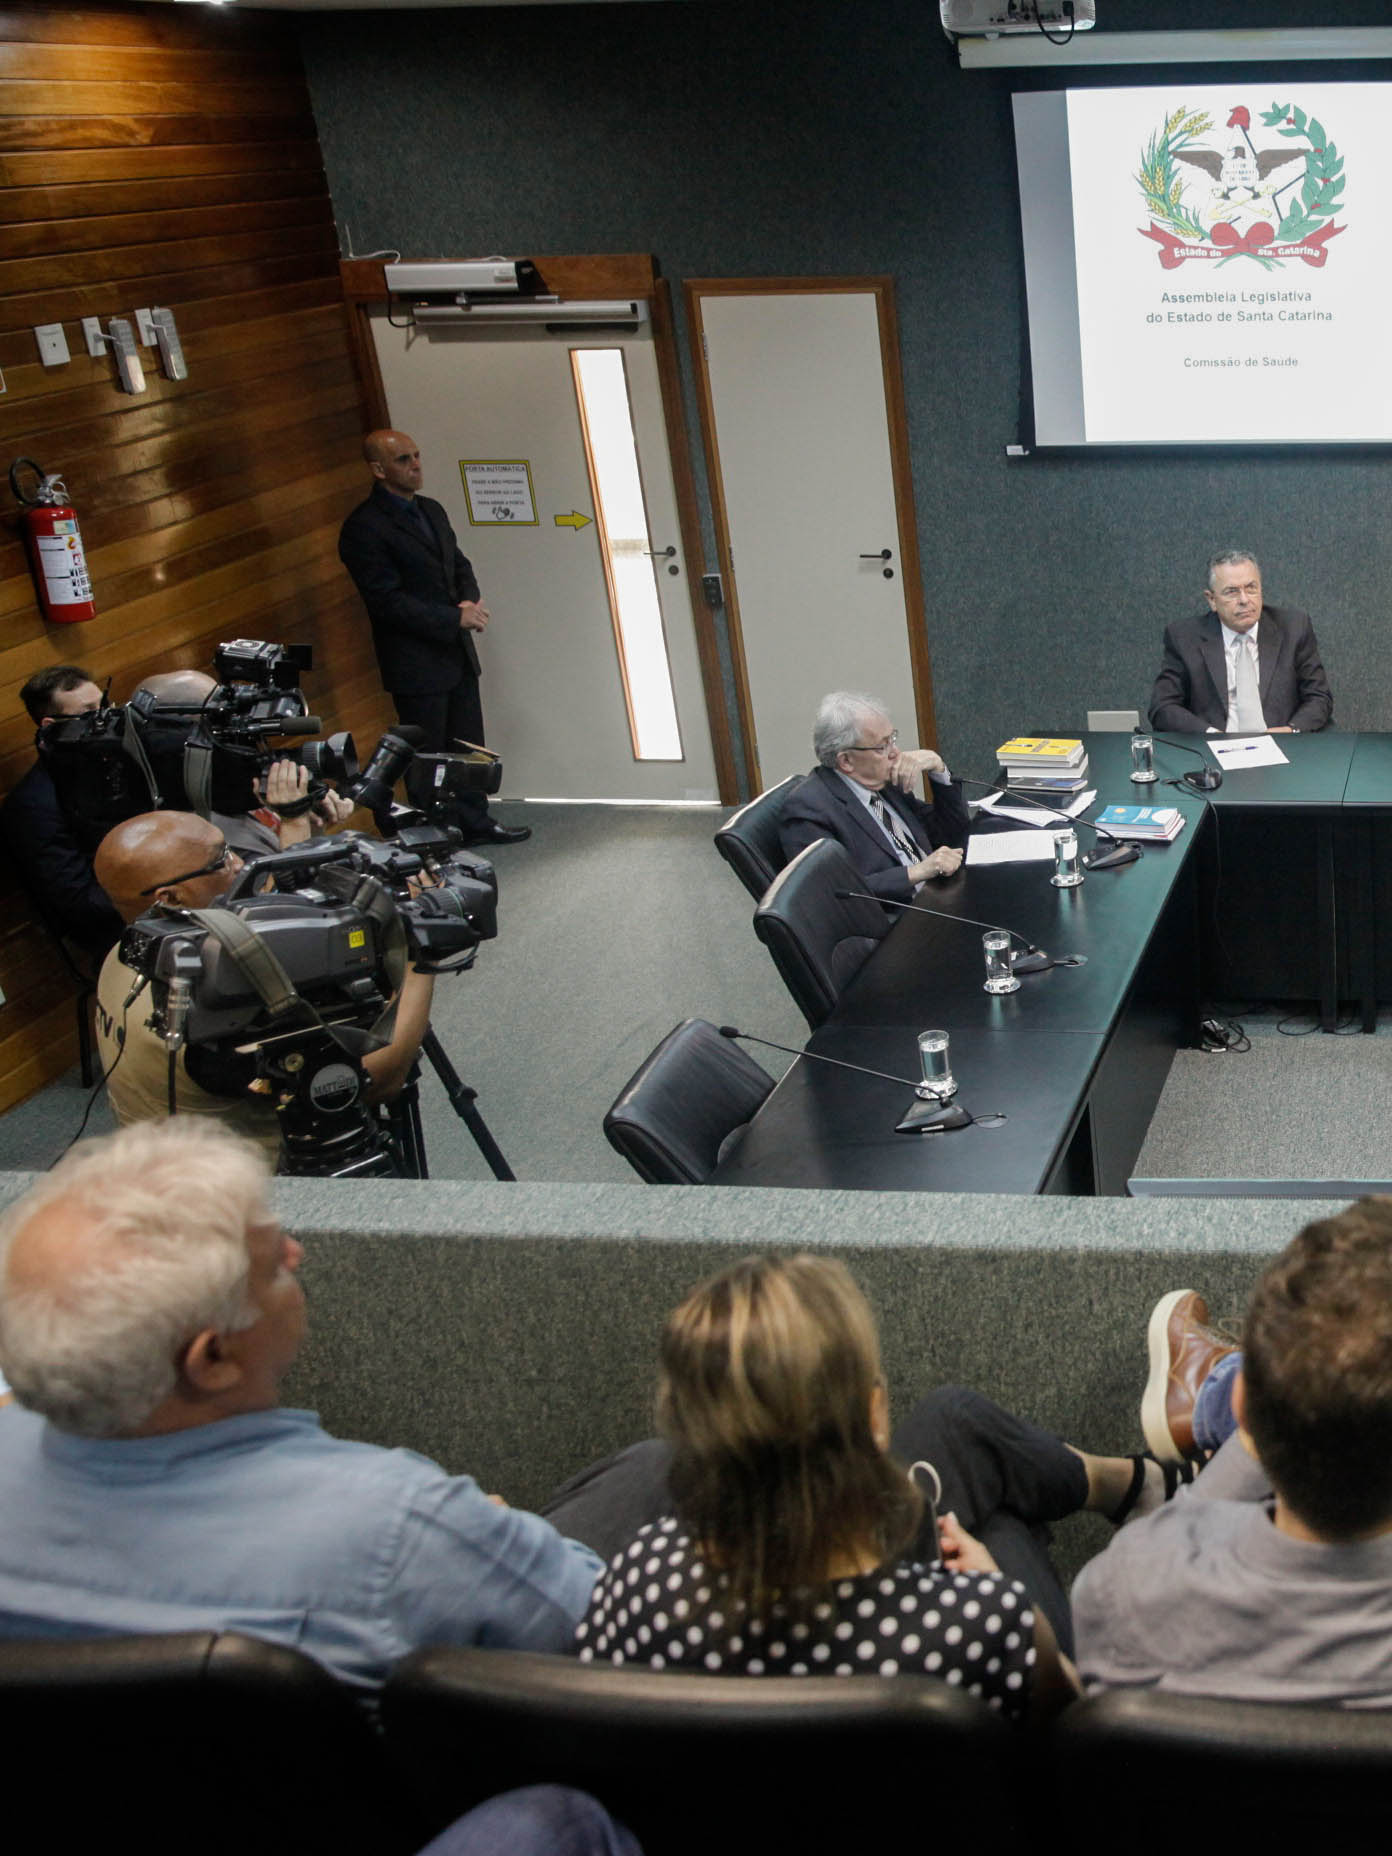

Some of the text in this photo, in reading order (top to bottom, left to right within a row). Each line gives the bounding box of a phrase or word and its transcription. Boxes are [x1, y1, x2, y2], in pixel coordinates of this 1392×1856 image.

[1161, 290, 1312, 305] Assembleia Legislativa
[1146, 309, 1333, 323] do Estado de Santa Catarina
[1184, 357, 1241, 368] Comissão
[1245, 357, 1259, 367] de
